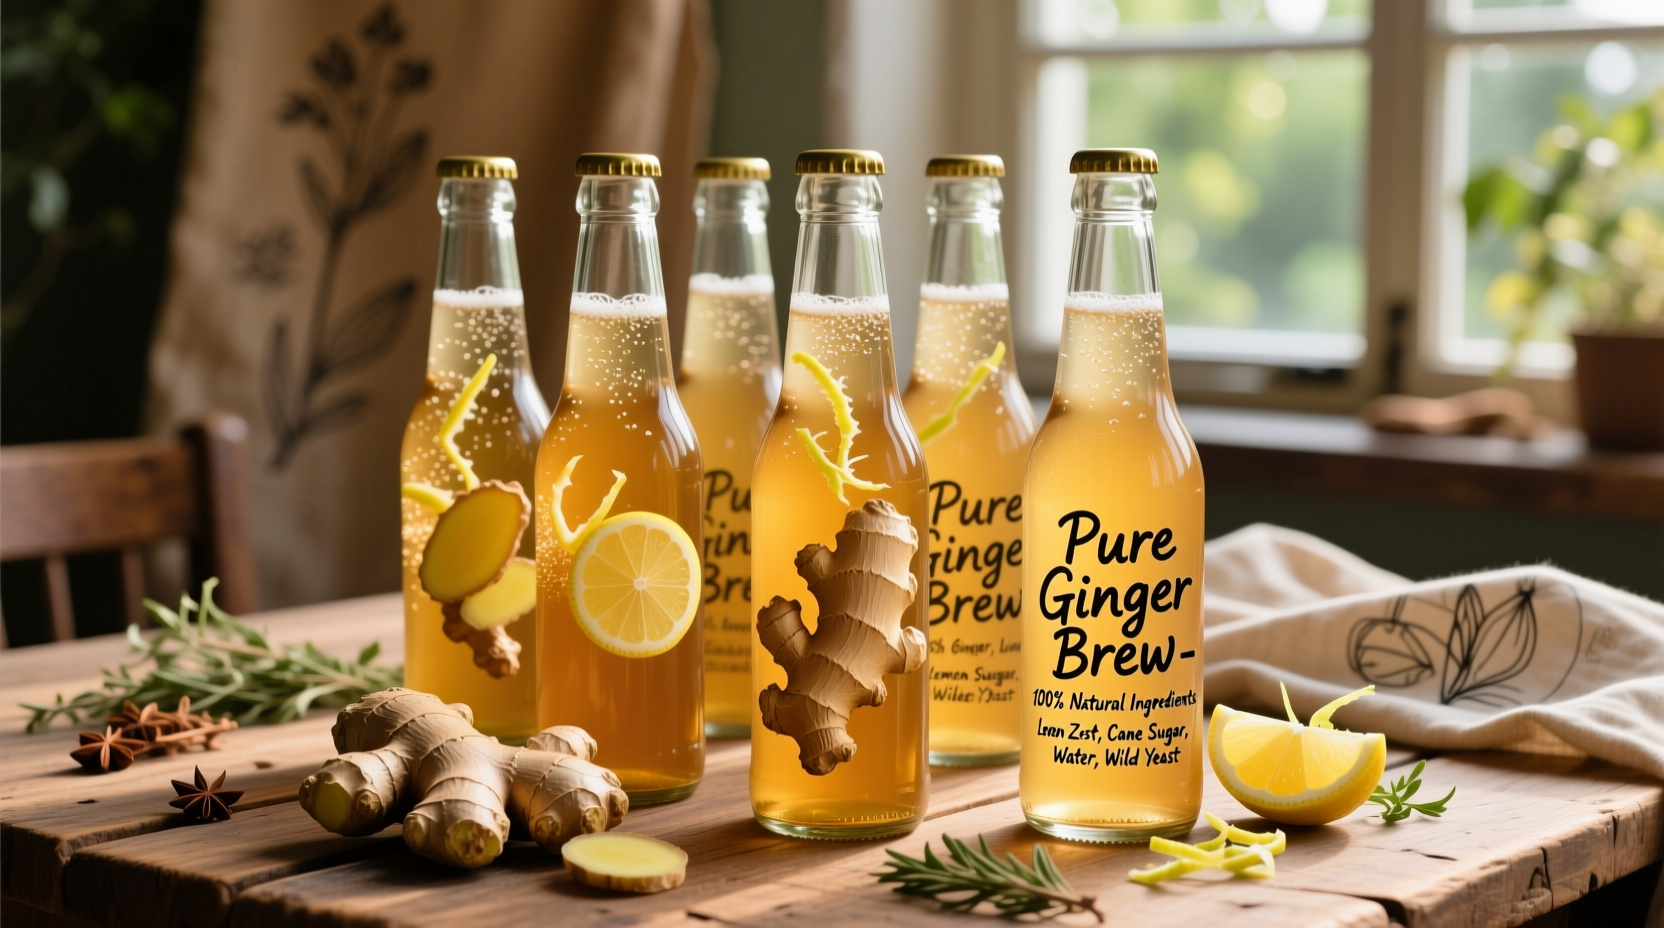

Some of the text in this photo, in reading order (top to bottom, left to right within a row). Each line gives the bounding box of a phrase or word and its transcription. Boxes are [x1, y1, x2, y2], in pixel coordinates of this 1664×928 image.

[704, 469, 751, 512] Pu
[929, 480, 1022, 526] Pure
[929, 528, 1022, 589] inge
[1057, 510, 1177, 565] Pure
[1039, 565, 1193, 639] Ginger
[1052, 626, 1196, 680] Brew-
[1033, 688, 1197, 719] 100% Natural Ingredients
[1053, 745, 1181, 770] Water, Wild Yeast
[1067, 723, 1102, 744] Zest,
[1107, 723, 1143, 742] Cane
[1147, 722, 1189, 747] Sugar,
